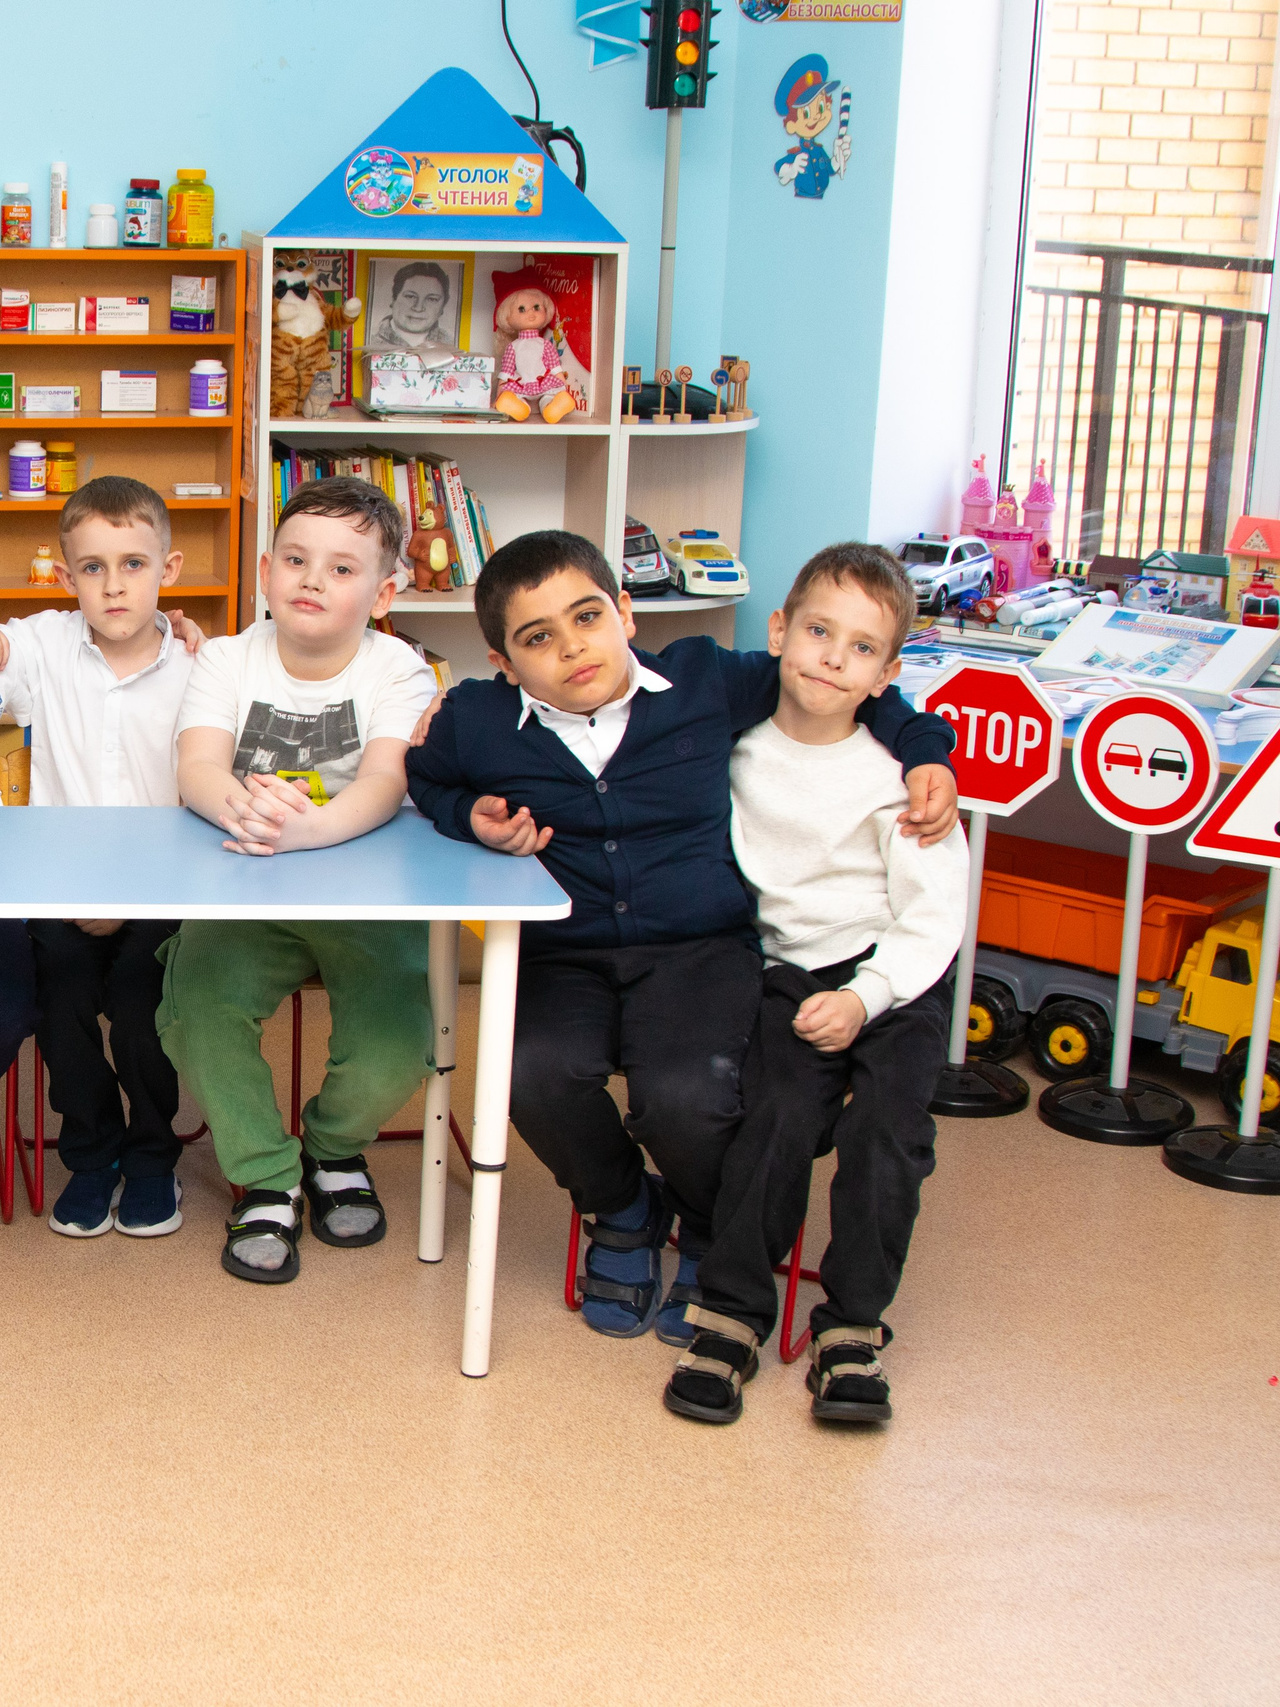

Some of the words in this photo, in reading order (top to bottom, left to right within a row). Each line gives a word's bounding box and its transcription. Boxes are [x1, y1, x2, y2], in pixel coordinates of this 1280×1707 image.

[789, 4, 900, 17] БЕЗОПАСНОСТИ
[438, 168, 509, 183] УГОЛОК
[438, 191, 508, 206] ЧТЕНИЯ
[287, 714, 304, 722] STREET
